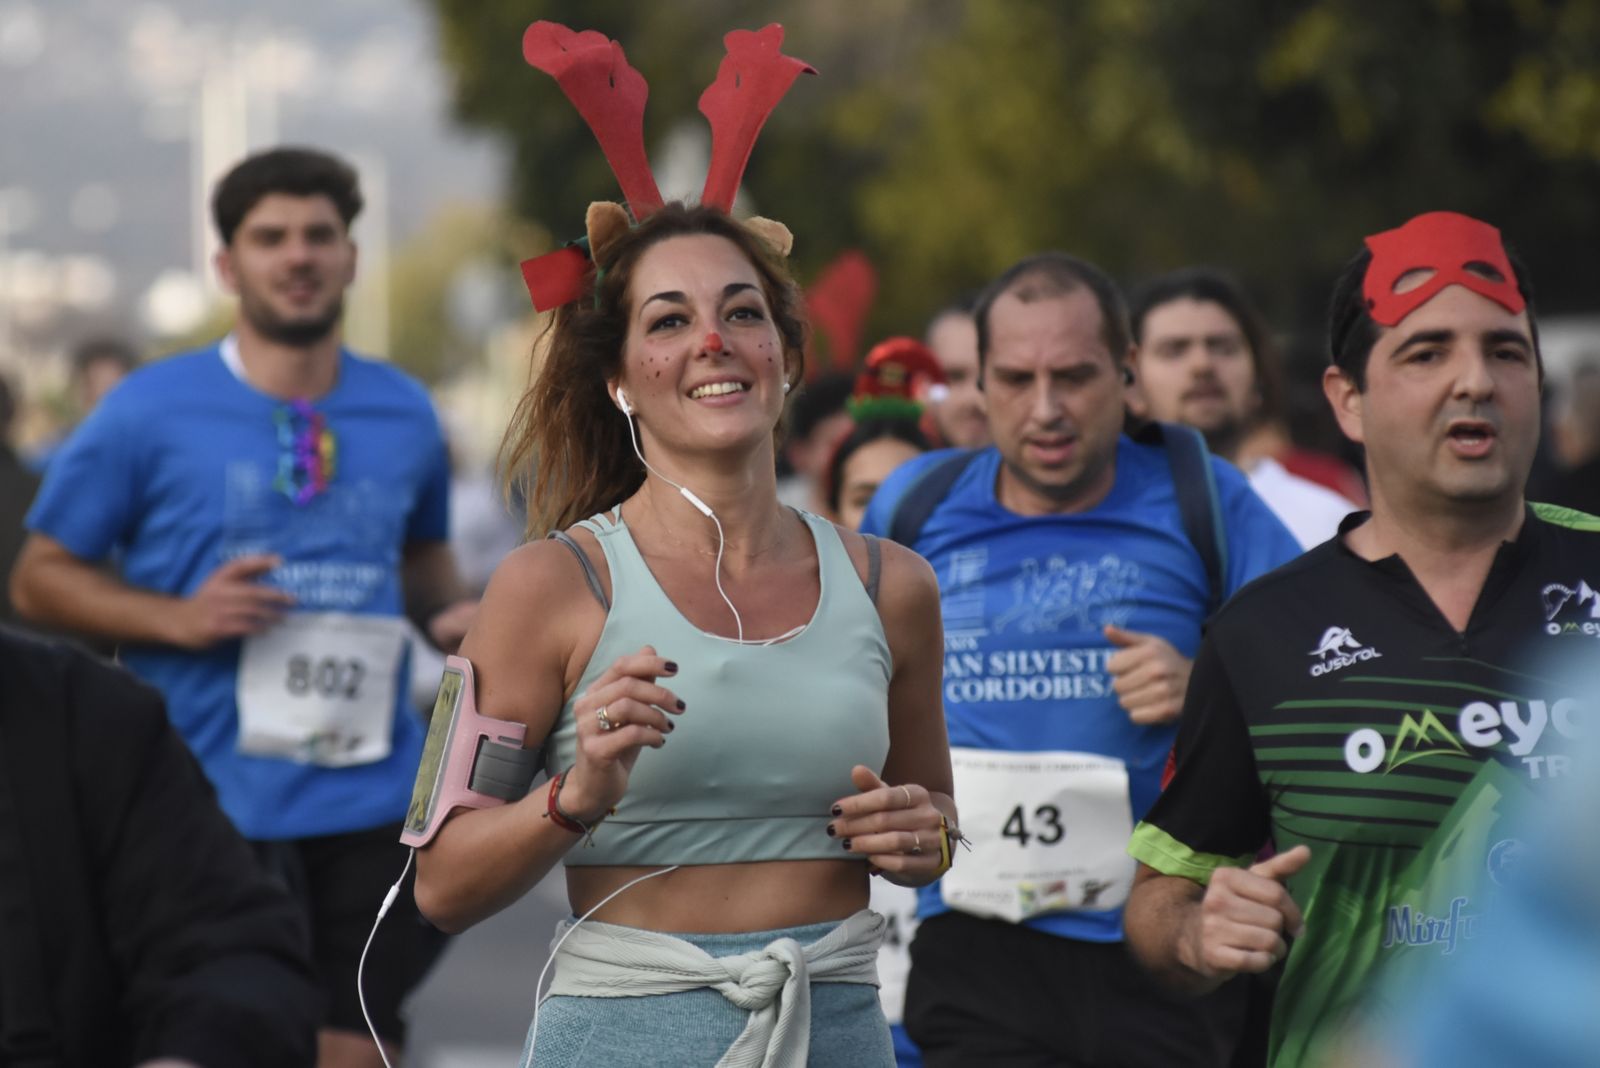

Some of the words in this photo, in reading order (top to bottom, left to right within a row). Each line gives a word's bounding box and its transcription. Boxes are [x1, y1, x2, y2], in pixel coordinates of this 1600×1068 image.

[285, 655, 366, 700] 802
[944, 652, 983, 677] AN
[1002, 804, 1065, 848] 43
